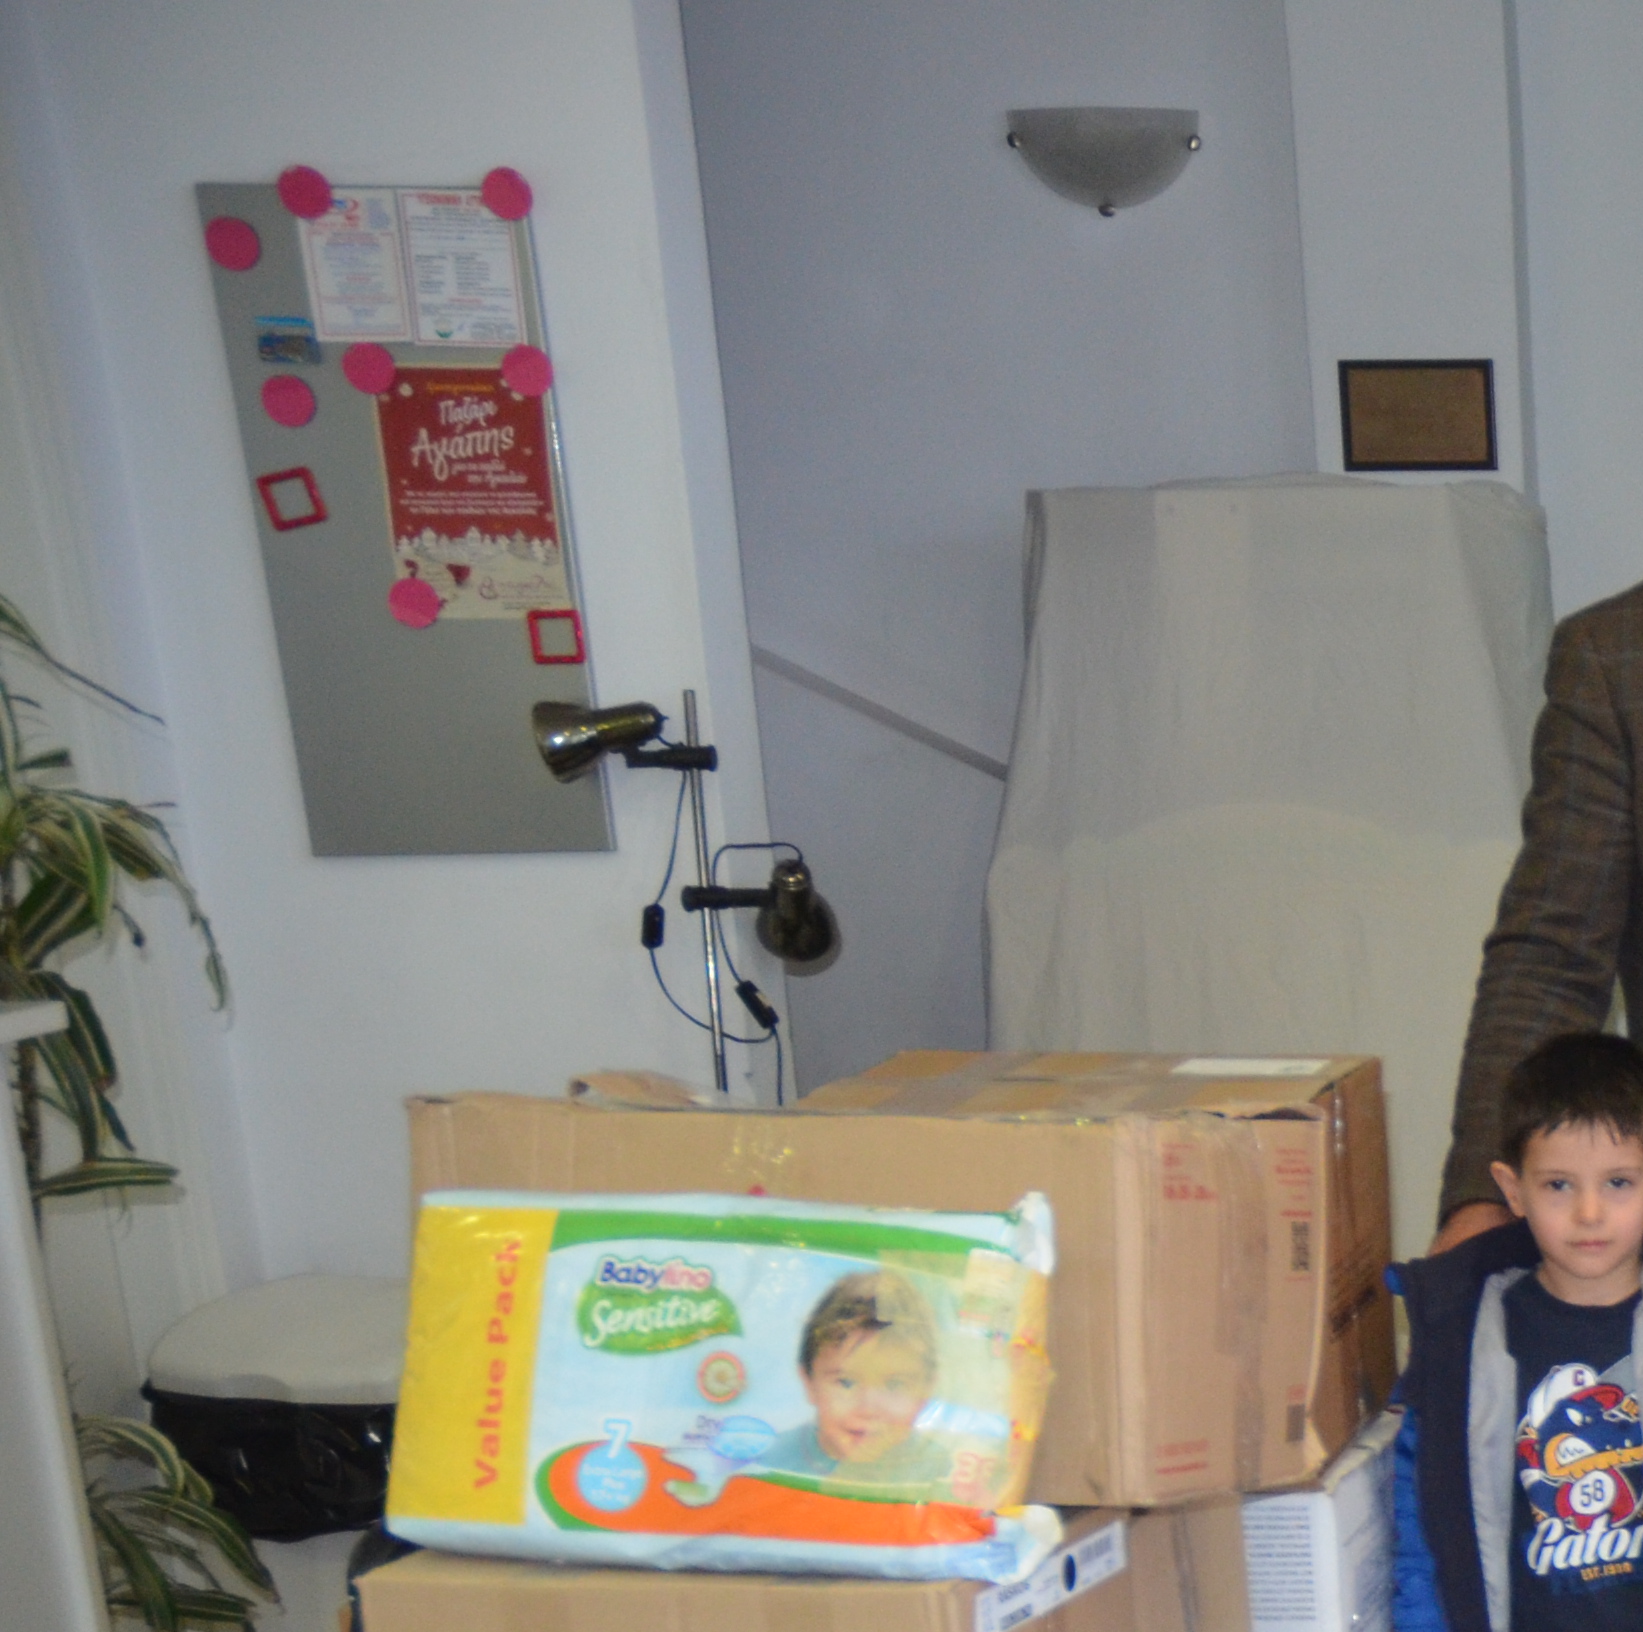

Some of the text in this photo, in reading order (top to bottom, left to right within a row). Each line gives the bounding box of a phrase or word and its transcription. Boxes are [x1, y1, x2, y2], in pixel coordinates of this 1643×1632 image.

[600, 1259, 713, 1290] Babylino
[473, 1240, 523, 1489] Value Pack
[1580, 1478, 1606, 1507] 58
